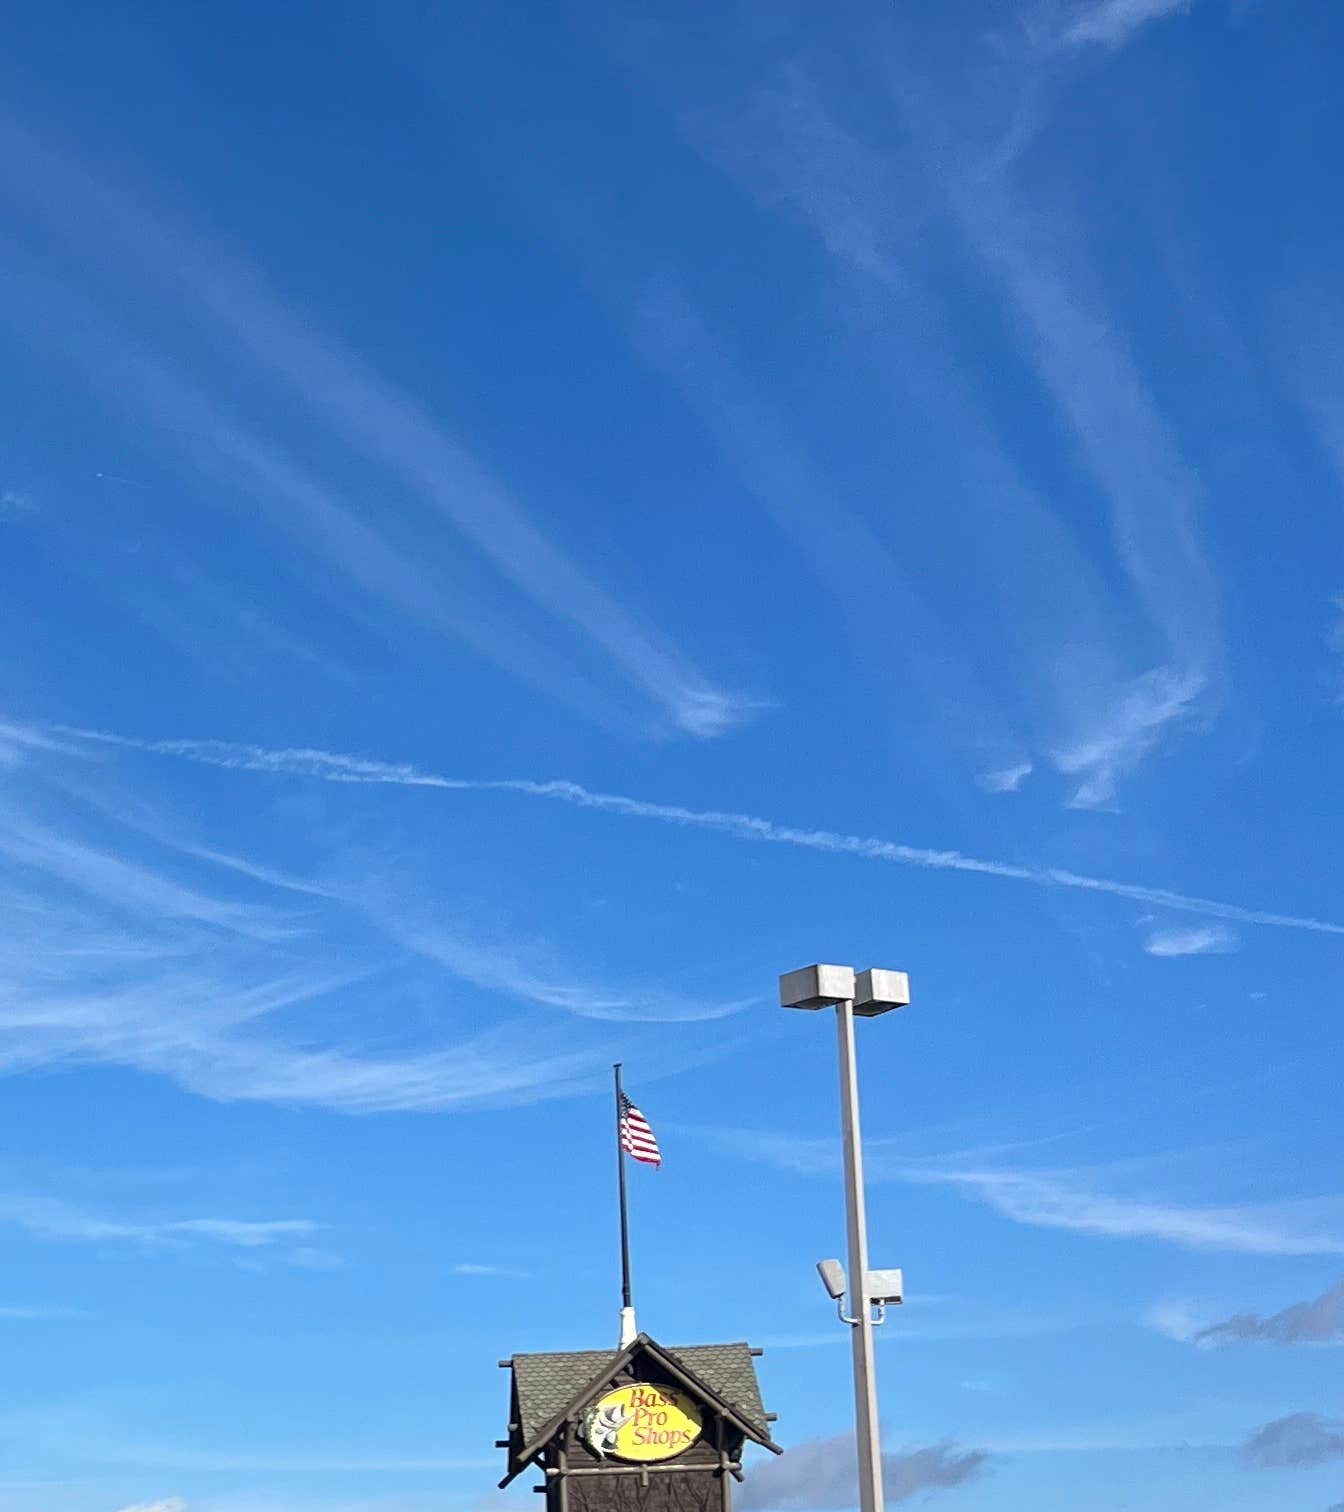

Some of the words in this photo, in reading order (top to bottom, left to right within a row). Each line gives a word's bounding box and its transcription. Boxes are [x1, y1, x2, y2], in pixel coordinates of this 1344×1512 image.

[629, 1388, 678, 1407] Bass
[631, 1407, 668, 1426] Pro
[631, 1427, 692, 1448] Shops
